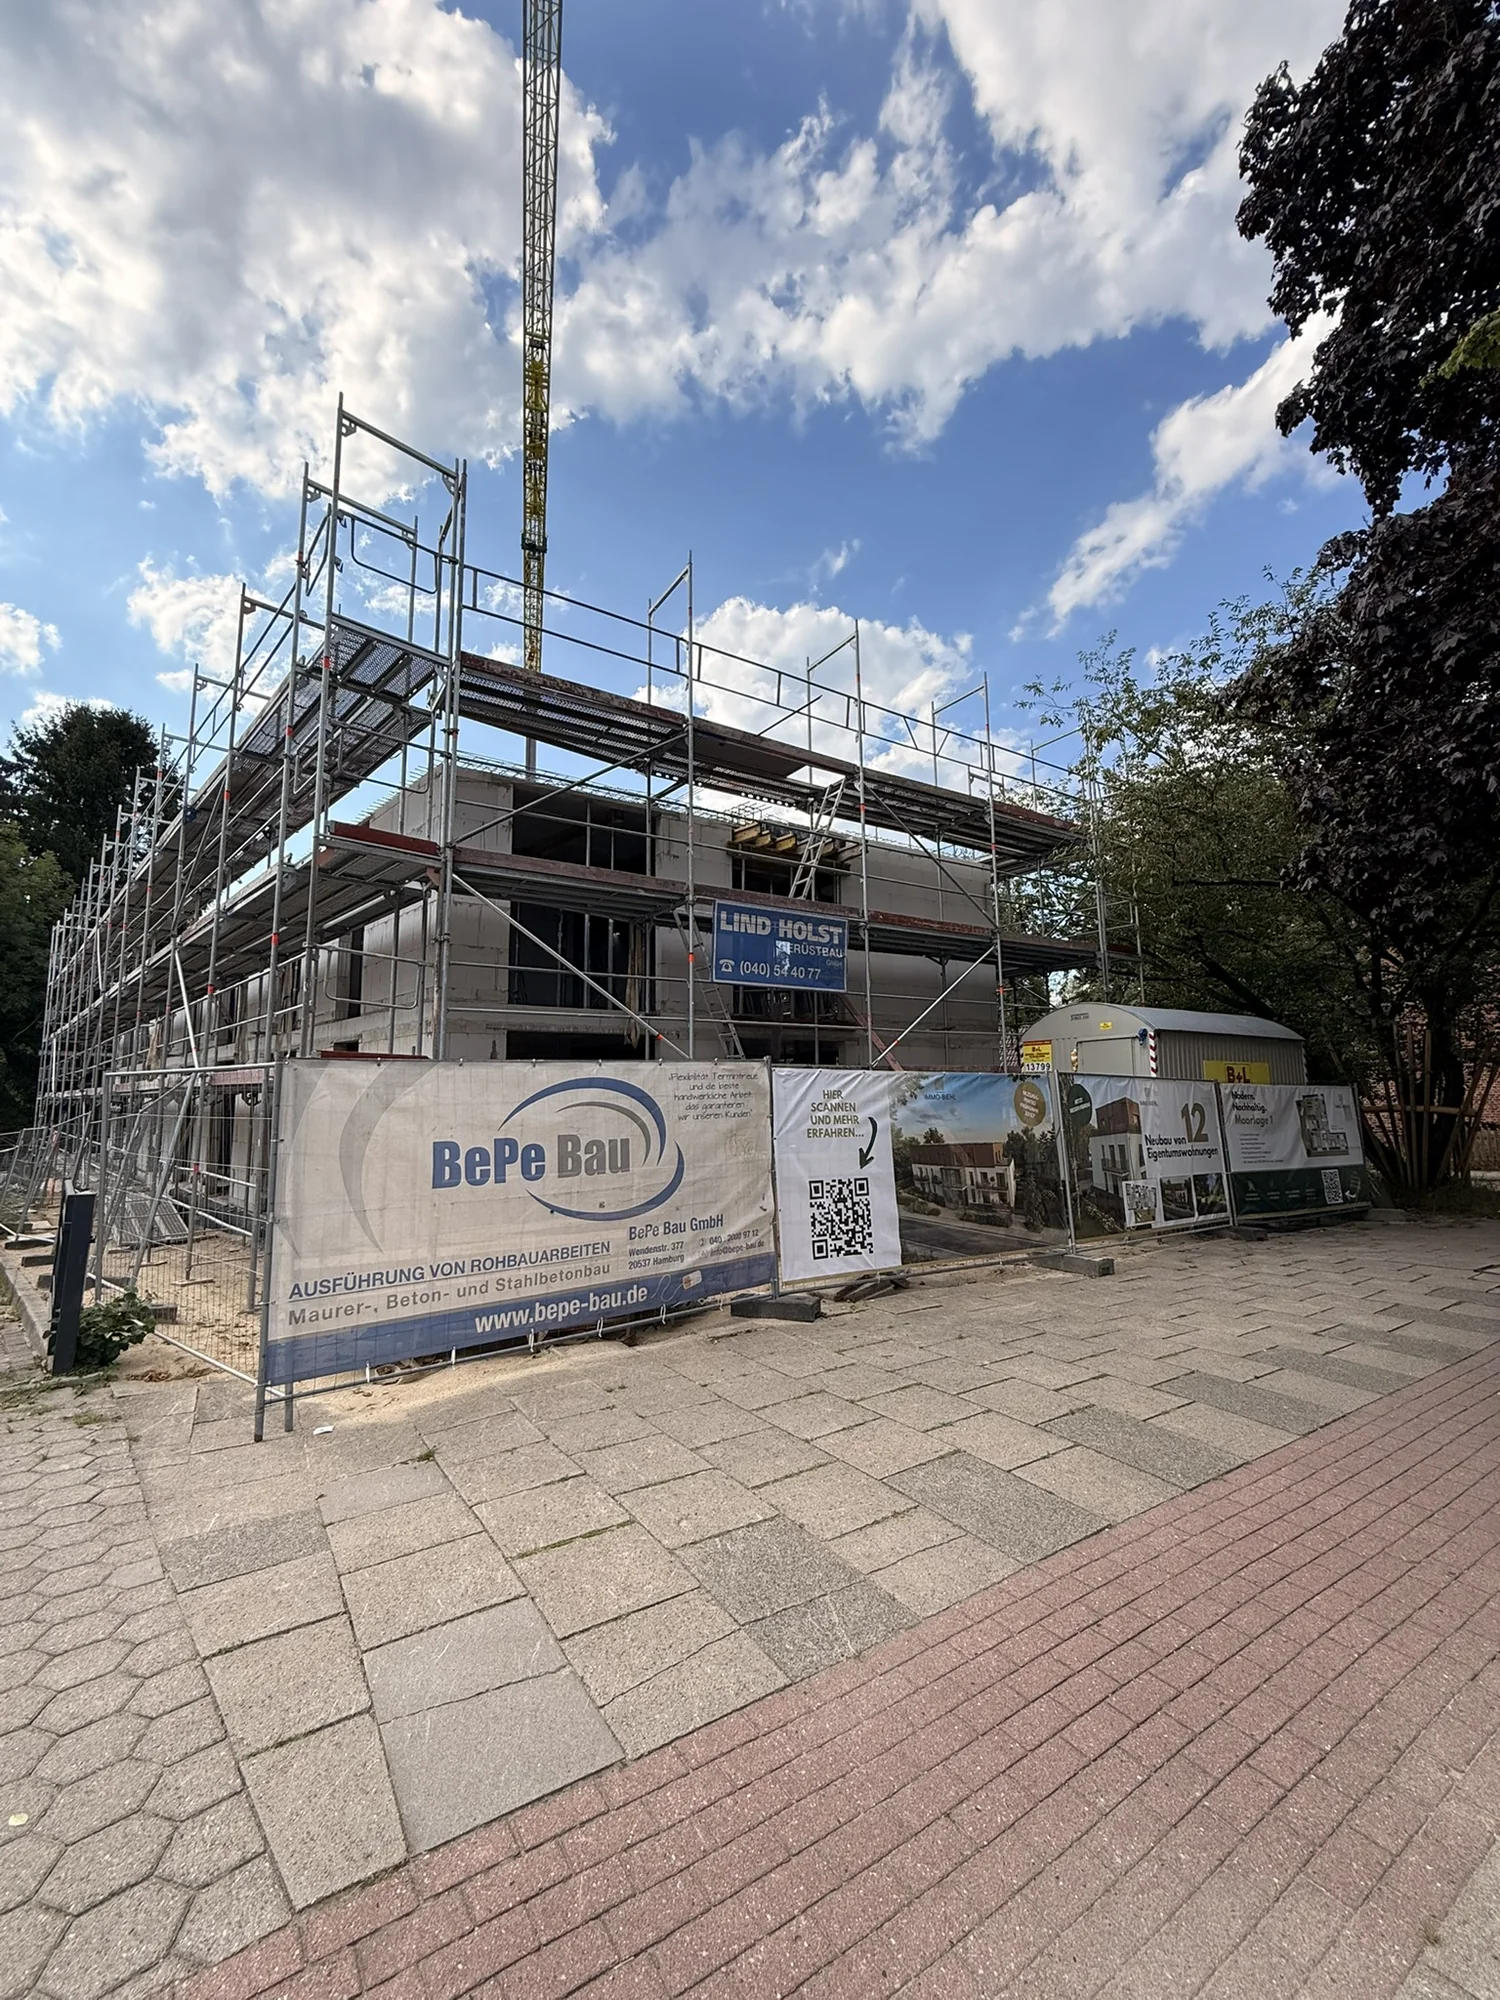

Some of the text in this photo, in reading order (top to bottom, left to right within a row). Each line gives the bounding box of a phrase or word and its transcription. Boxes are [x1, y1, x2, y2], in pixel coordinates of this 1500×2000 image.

[720, 911, 772, 935] LIND
[779, 919, 843, 944] HOLST
[740, 961, 821, 980] (040) 54 40 77
[1026, 1063, 1051, 1071] 13799
[689, 1083, 703, 1091] und
[718, 1082, 740, 1090] beste
[673, 1091, 728, 1101] handwerkliche
[822, 1089, 844, 1100] HIER
[1231, 1090, 1256, 1101] Modern.
[685, 1101, 745, 1113] das garantieren
[810, 1102, 857, 1112] SCANNEN
[1232, 1102, 1267, 1113] Nachhaltig.
[677, 1113, 690, 1121] wir
[692, 1112, 723, 1120] unseren
[810, 1114, 860, 1126] UND MEHR
[1181, 1102, 1209, 1143] 12
[1234, 1114, 1269, 1127] Moorlage
[807, 1128, 865, 1138] ERFAHREN...
[1144, 1134, 1187, 1146] Neubau von
[1146, 1145, 1219, 1162] Eigentumswohnungen
[432, 1134, 630, 1189] BePe Bau
[629, 1213, 724, 1241] BePe Bau GmbH
[742, 1230, 751, 1239] 97
[752, 1229, 760, 1237] 12
[628, 1241, 684, 1257] Wendenstr. 377
[628, 1253, 685, 1270] 20537 Hamburg
[288, 1241, 611, 1300] AUSFÜHRUNG VON ROHBAUARBEITEN
[288, 1263, 611, 1326] Maurer-, Beton- und Stahlbetonbau
[474, 1284, 648, 1333] www.bepe-bau.de
